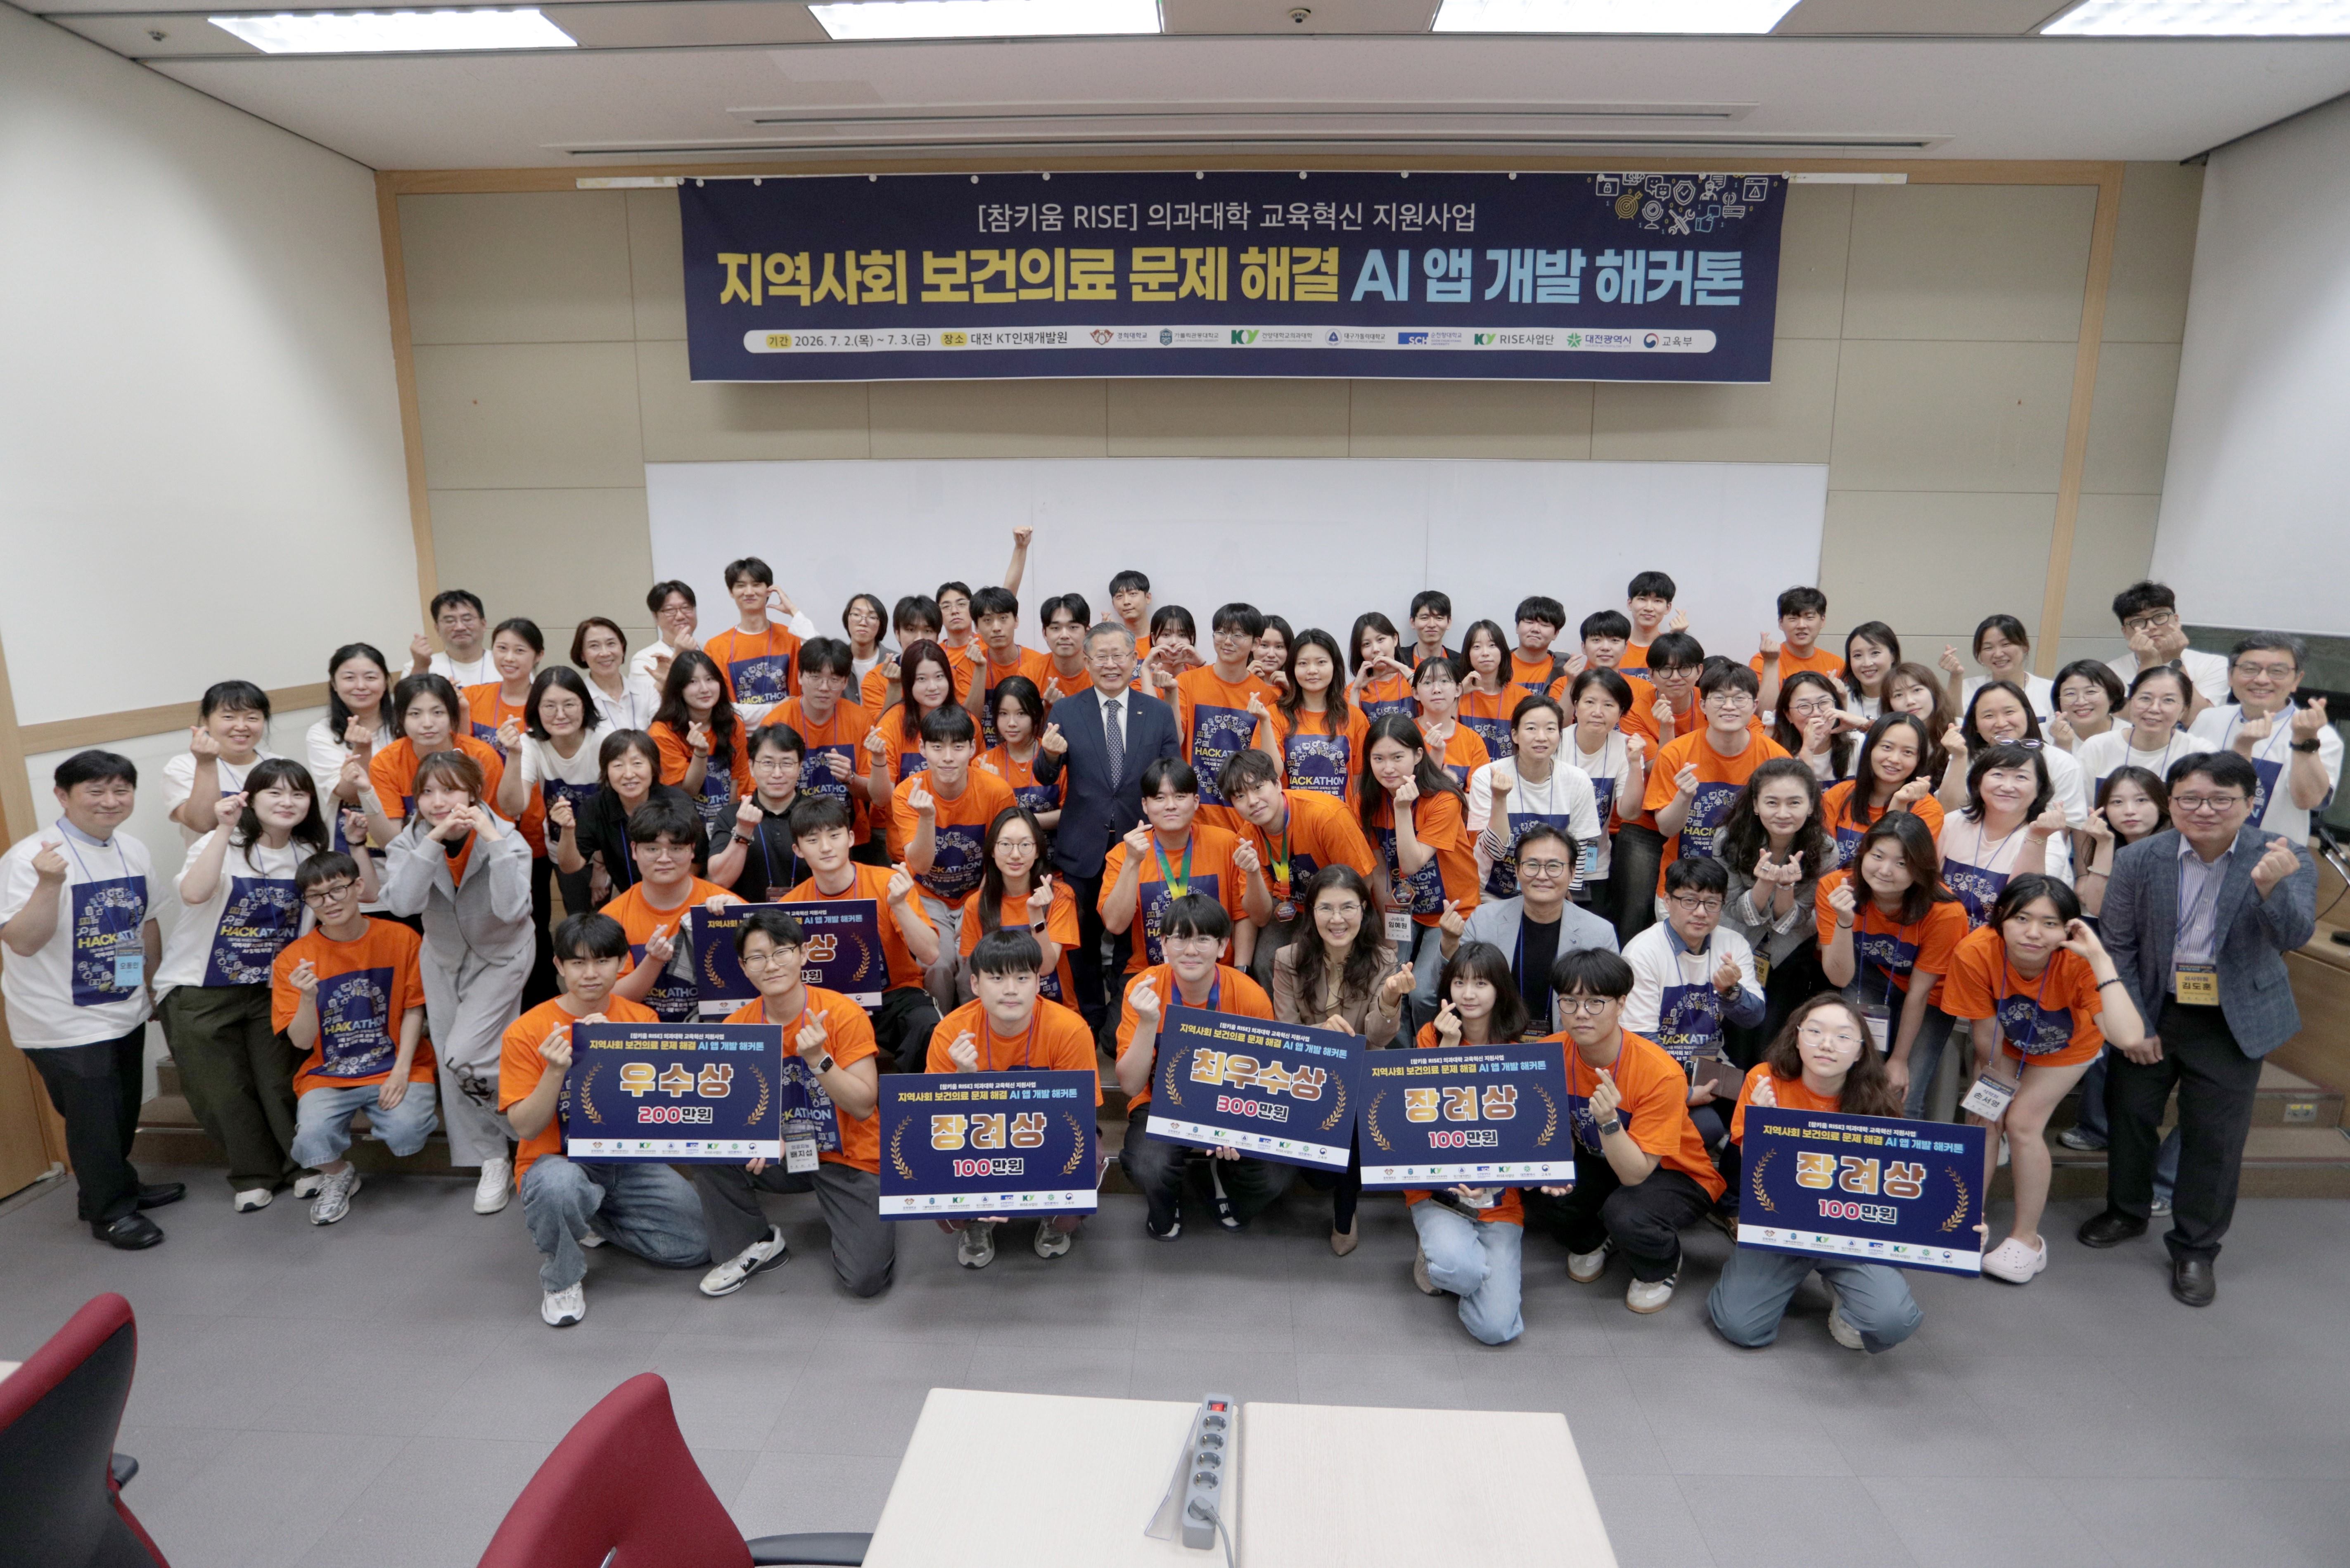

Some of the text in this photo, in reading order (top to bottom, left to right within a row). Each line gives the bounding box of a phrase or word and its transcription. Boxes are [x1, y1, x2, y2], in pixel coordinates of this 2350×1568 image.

[979, 202, 1475, 232] [참키움 RISE] 의과대학 교육혁신 지원사업
[717, 247, 1743, 306] 지역사회 보건의료 문제 해결 AI 앱 개발 해커톤
[769, 336, 789, 346] 기간
[795, 336, 826, 346] 2026.
[830, 336, 840, 346] 7.
[844, 334, 873, 348] 2.(목)
[888, 335, 897, 345] 7.
[901, 334, 931, 346] 3.(금)
[943, 332, 1067, 345] 장소 대전 KT인재개발원
[1500, 334, 1554, 345] RISE사업단
[1585, 335, 1631, 344] 대전광역시
[1662, 336, 1692, 347] 교육부
[707, 920, 737, 928] 지역사회
[804, 916, 813, 924] AI
[815, 916, 823, 924] 앱
[824, 915, 839, 924] 개발
[840, 914, 863, 923] 해커톤
[1180, 1023, 1347, 1059] 지역사회 보건의료 문제 해결 AI 앱 개발 해커톤
[1219, 1022, 1236, 1030] [참키움
[1251, 1028, 1271, 1036] 의과대학
[1271, 1031, 1290, 1039] 교육혁신
[1291, 1034, 1310, 1042] 지원사업
[589, 1040, 764, 1051] 지역사회 보건의료 문제 해결 AI 앱 개발 해커톤
[1190, 1048, 1327, 1101] 최우수상
[1372, 1061, 1546, 1077] 지역사회 보건의료 문제 해결 AI 앱 개발 해커톤
[619, 1062, 734, 1099] 우수상
[898, 1088, 1077, 1102] 지역사회 보건의료 문제 해결 AI 앱 개발 해커톤
[1405, 1085, 1518, 1123] 장려상
[638, 1106, 713, 1124] 200만원
[1216, 1095, 1289, 1123] 300만원
[931, 1112, 1047, 1151] 장려상
[1428, 1129, 1498, 1149] 100만원
[1763, 1125, 1963, 1153] 지역사회 보건의료 문제 해결 AI 앱 개발 해커톤
[1845, 1125, 1869, 1133] 의과대학
[1869, 1127, 1892, 1135] 교육혁신
[1893, 1129, 1916, 1137] 지원사업
[953, 1158, 1024, 1177] 100만원
[1796, 1151, 1926, 1199] 장려상
[1819, 1199, 1897, 1225] 100만원
